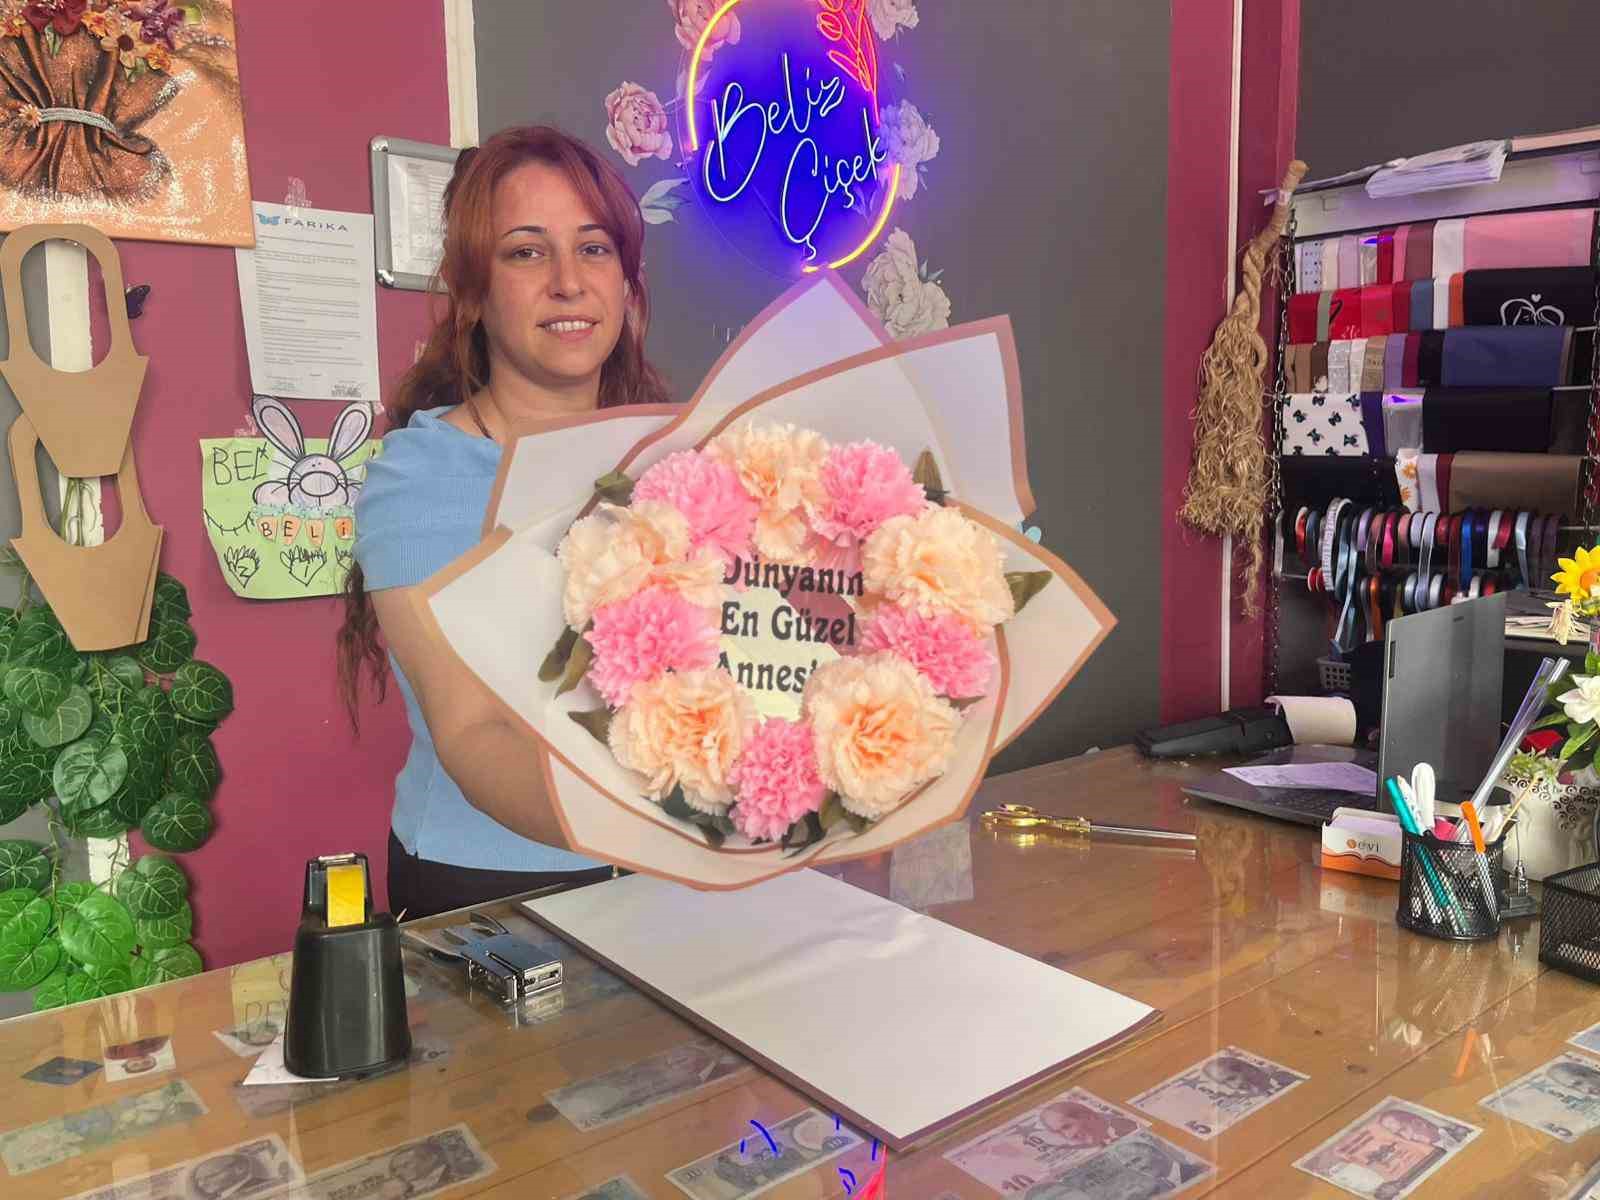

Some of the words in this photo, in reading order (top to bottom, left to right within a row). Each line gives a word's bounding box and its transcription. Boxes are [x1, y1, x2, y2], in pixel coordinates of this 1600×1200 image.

[705, 52, 845, 202] Beliz
[781, 107, 886, 261] Çiçek
[720, 601, 759, 637] En
[771, 605, 856, 646] Güzel
